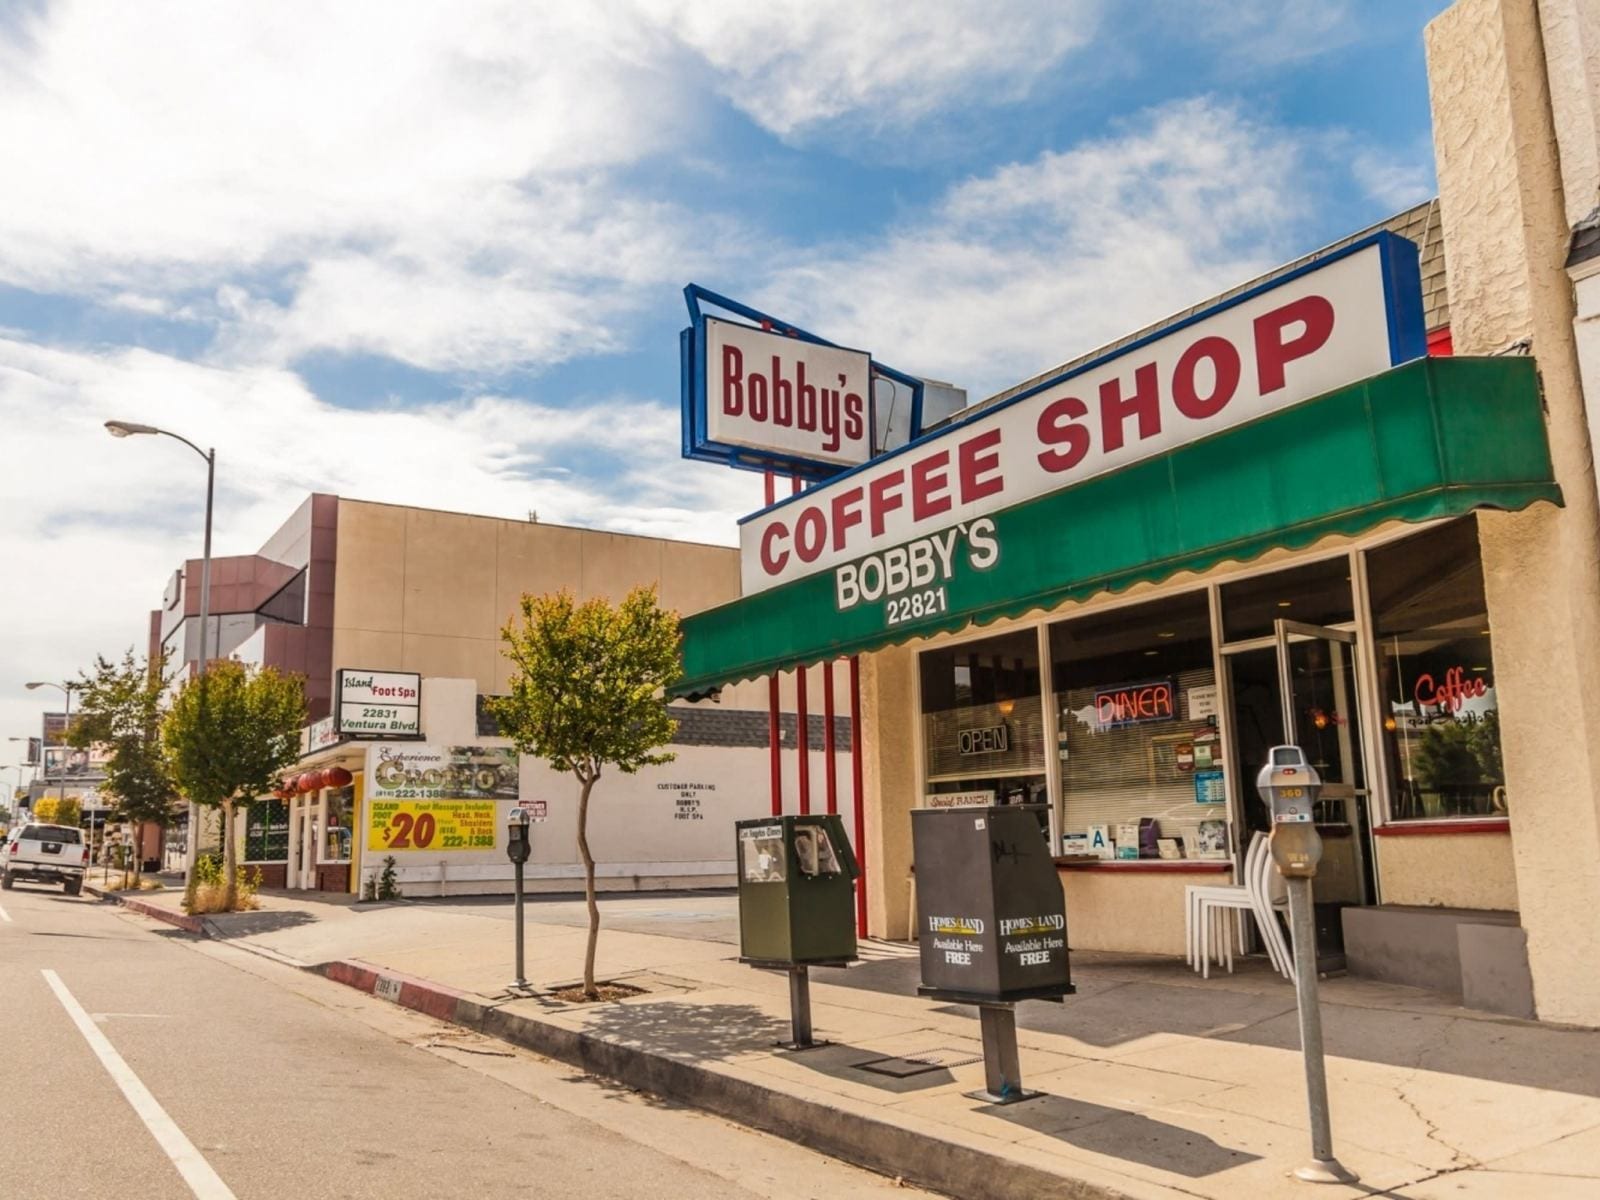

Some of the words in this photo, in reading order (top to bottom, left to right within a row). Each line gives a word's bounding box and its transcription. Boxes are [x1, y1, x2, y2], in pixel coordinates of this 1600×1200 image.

[722, 344, 864, 452] Bobby's
[760, 428, 1004, 576] COFFEE
[1036, 295, 1335, 473] SHOP
[835, 518, 999, 610] BOBBY'S
[887, 587, 947, 626] 22821
[344, 676, 373, 689] Island
[1415, 666, 1487, 713] Coffee
[372, 685, 396, 697] Foot
[398, 687, 416, 698] Spa
[1098, 686, 1170, 722] DINER
[362, 708, 398, 719] 22831
[341, 719, 387, 730] Ventura
[390, 721, 418, 730] Blvd.
[961, 728, 1005, 753] OPEN
[379, 746, 441, 762] Experience
[395, 789, 447, 798] 222-1388
[689, 783, 715, 791] PARKING
[373, 803, 399, 811] ISLAND
[373, 820, 387, 828] SPA
[443, 836, 494, 847] 222-1388
[1093, 830, 1104, 848] A
[961, 918, 984, 934] LAND
[1040, 914, 1064, 930] LAND
[933, 937, 963, 950] Available
[965, 940, 984, 952] Here
[1005, 939, 1042, 953] Available
[1044, 938, 1063, 949] Here
[945, 951, 971, 965] FREE
[1020, 951, 1050, 966] FREE
